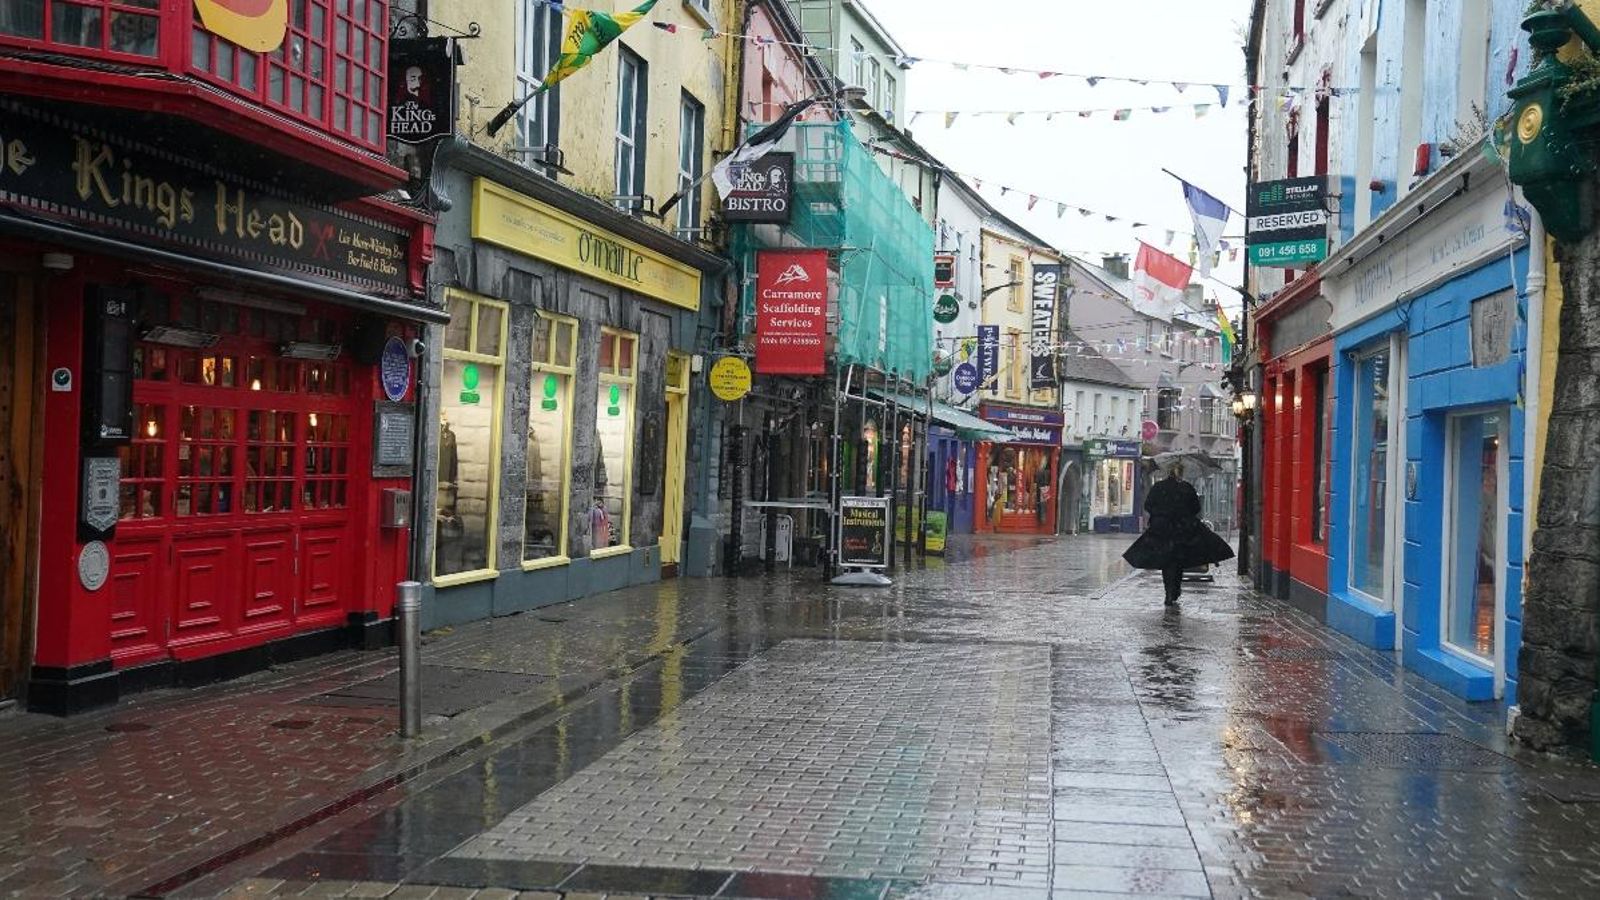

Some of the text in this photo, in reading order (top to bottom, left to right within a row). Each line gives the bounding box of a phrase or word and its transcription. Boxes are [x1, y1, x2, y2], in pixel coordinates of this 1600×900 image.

[390, 121, 432, 133] HEAD
[71, 134, 195, 231] Kings
[215, 180, 304, 250] Head
[727, 197, 786, 212] BISTRO
[1256, 211, 1319, 230] RESERVED
[1258, 243, 1317, 258] 091 456 658
[762, 289, 822, 300] Carramore
[762, 302, 821, 316] Scaffolding
[1032, 271, 1057, 358] SWEATERS
[770, 317, 812, 328] Services
[850, 508, 879, 519] Musical
[843, 517, 885, 527] Instruments
